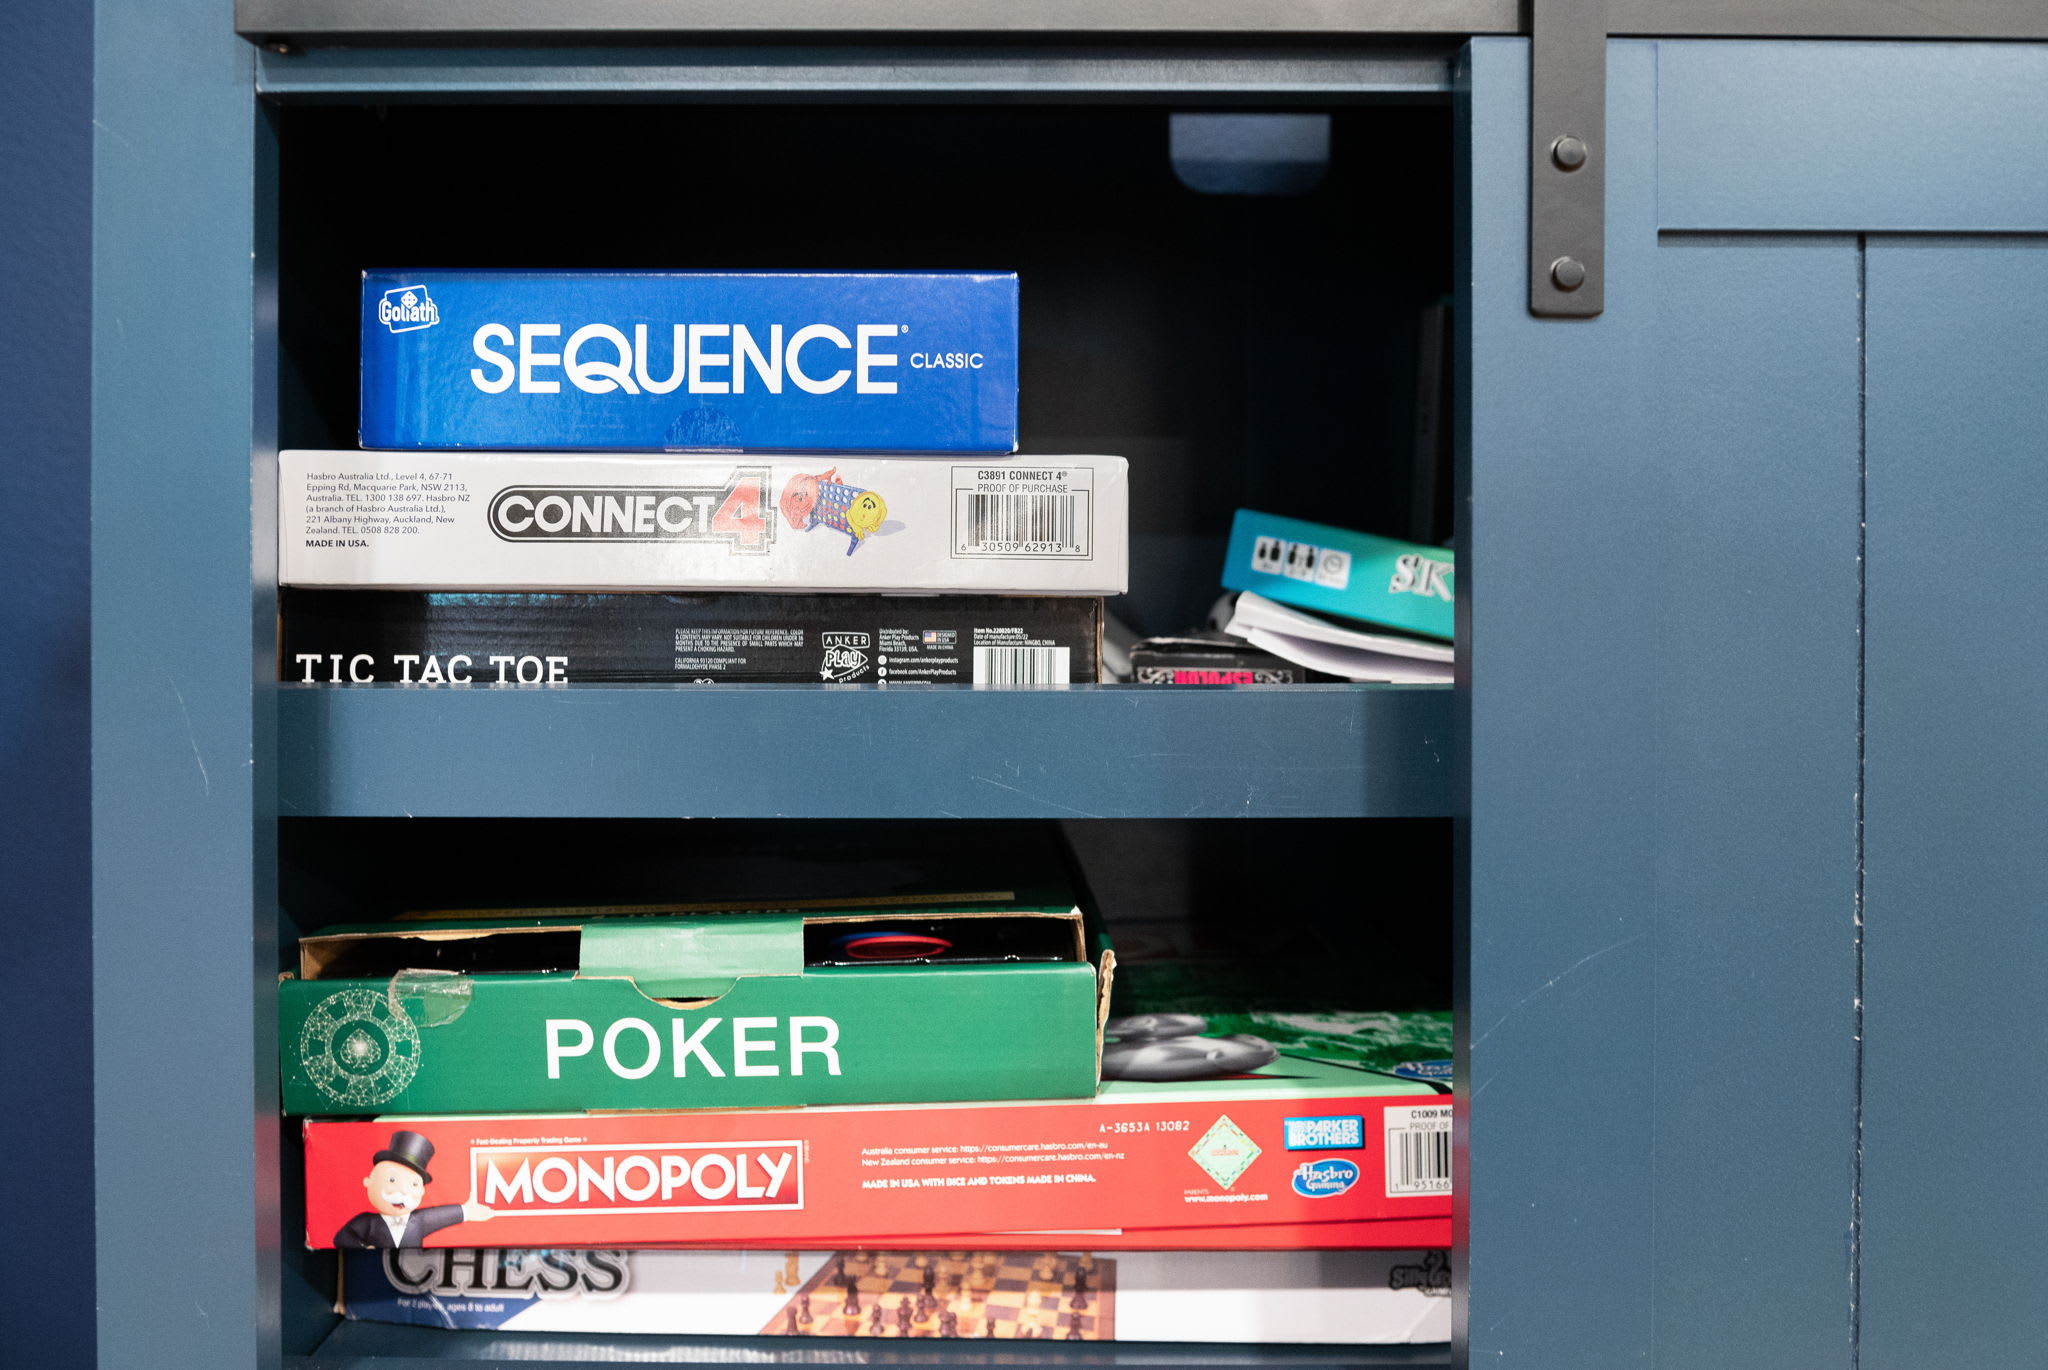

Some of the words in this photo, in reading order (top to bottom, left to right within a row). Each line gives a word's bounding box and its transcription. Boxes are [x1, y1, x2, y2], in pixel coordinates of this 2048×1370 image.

[381, 300, 435, 322] Goliath
[910, 352, 984, 369] CLASSIC
[307, 472, 336, 481] Hasbro
[338, 472, 373, 481] Australia
[396, 472, 417, 481] Level
[419, 472, 427, 481] 4,
[428, 472, 452, 481] 67-71
[978, 470, 1006, 480] C3891
[1009, 470, 1053, 481] CONNECT
[306, 483, 336, 492] Epping
[338, 483, 351, 492] Rd,
[353, 483, 397, 492] Macquarie
[399, 483, 419, 492] Park,
[421, 483, 441, 492] NSW
[443, 483, 467, 492] 2113,
[978, 483, 1007, 493] PROOF
[1009, 483, 1020, 493] OF
[1022, 484, 1068, 493] PURCHASE
[365, 493, 385, 502] 1300
[389, 493, 404, 502] 138
[426, 493, 455, 502] Hasbro
[458, 493, 471, 502] NZ
[305, 504, 314, 513] (a
[316, 504, 344, 513] branch
[346, 504, 354, 513] of
[356, 504, 385, 513] Hasbro
[387, 504, 423, 513] Australia
[497, 495, 716, 533] CONNECT
[711, 476, 767, 545] 4
[306, 516, 321, 524] 221
[323, 516, 351, 524] Albany
[354, 516, 391, 524] Highway,
[393, 516, 434, 524] Auckland,
[435, 516, 455, 524] New
[360, 526, 382, 534] 0508
[384, 526, 400, 534] 828
[402, 526, 420, 534] 200.
[305, 540, 333, 548] MADE
[335, 540, 346, 548] IN
[348, 540, 369, 548] USA.
[981, 542, 1019, 552] 30509
[1025, 543, 1062, 552] 62913
[825, 636, 867, 645] ANKER
[295, 653, 375, 684] TIC
[393, 654, 473, 684] TAC
[489, 655, 569, 684] TOE
[839, 664, 870, 684] products
[544, 1016, 843, 1080] POKER
[1411, 1109, 1438, 1119] C1009
[1099, 1122, 1150, 1134] A-3653A
[1156, 1120, 1190, 1132] 13082
[1308, 1119, 1359, 1134] PARKER
[1409, 1122, 1436, 1131] PROOF
[1439, 1122, 1450, 1130] OF
[513, 1137, 540, 1145] Property
[1288, 1131, 1360, 1147] BROTHERS
[861, 1147, 893, 1156] Australia
[894, 1147, 930, 1155] consumer
[862, 1159, 879, 1167] New
[880, 1157, 910, 1166] Zealand
[911, 1158, 947, 1166] consumer
[485, 1151, 793, 1205] MONOPOLY
[1297, 1164, 1354, 1182] Hasbro
[862, 1180, 888, 1189] MADE
[889, 1179, 900, 1188] IN
[901, 1179, 921, 1188] USA
[921, 1178, 945, 1187] WITH
[946, 1177, 966, 1186] DICE
[967, 1177, 988, 1186] AND
[989, 1176, 1025, 1185] TOKENS
[1026, 1175, 1052, 1184] MADE
[1054, 1174, 1064, 1183] IN
[1306, 1179, 1345, 1192] Gaming
[1184, 1193, 1269, 1203] www.monopoly.com
[388, 1249, 624, 1292] CHESS
